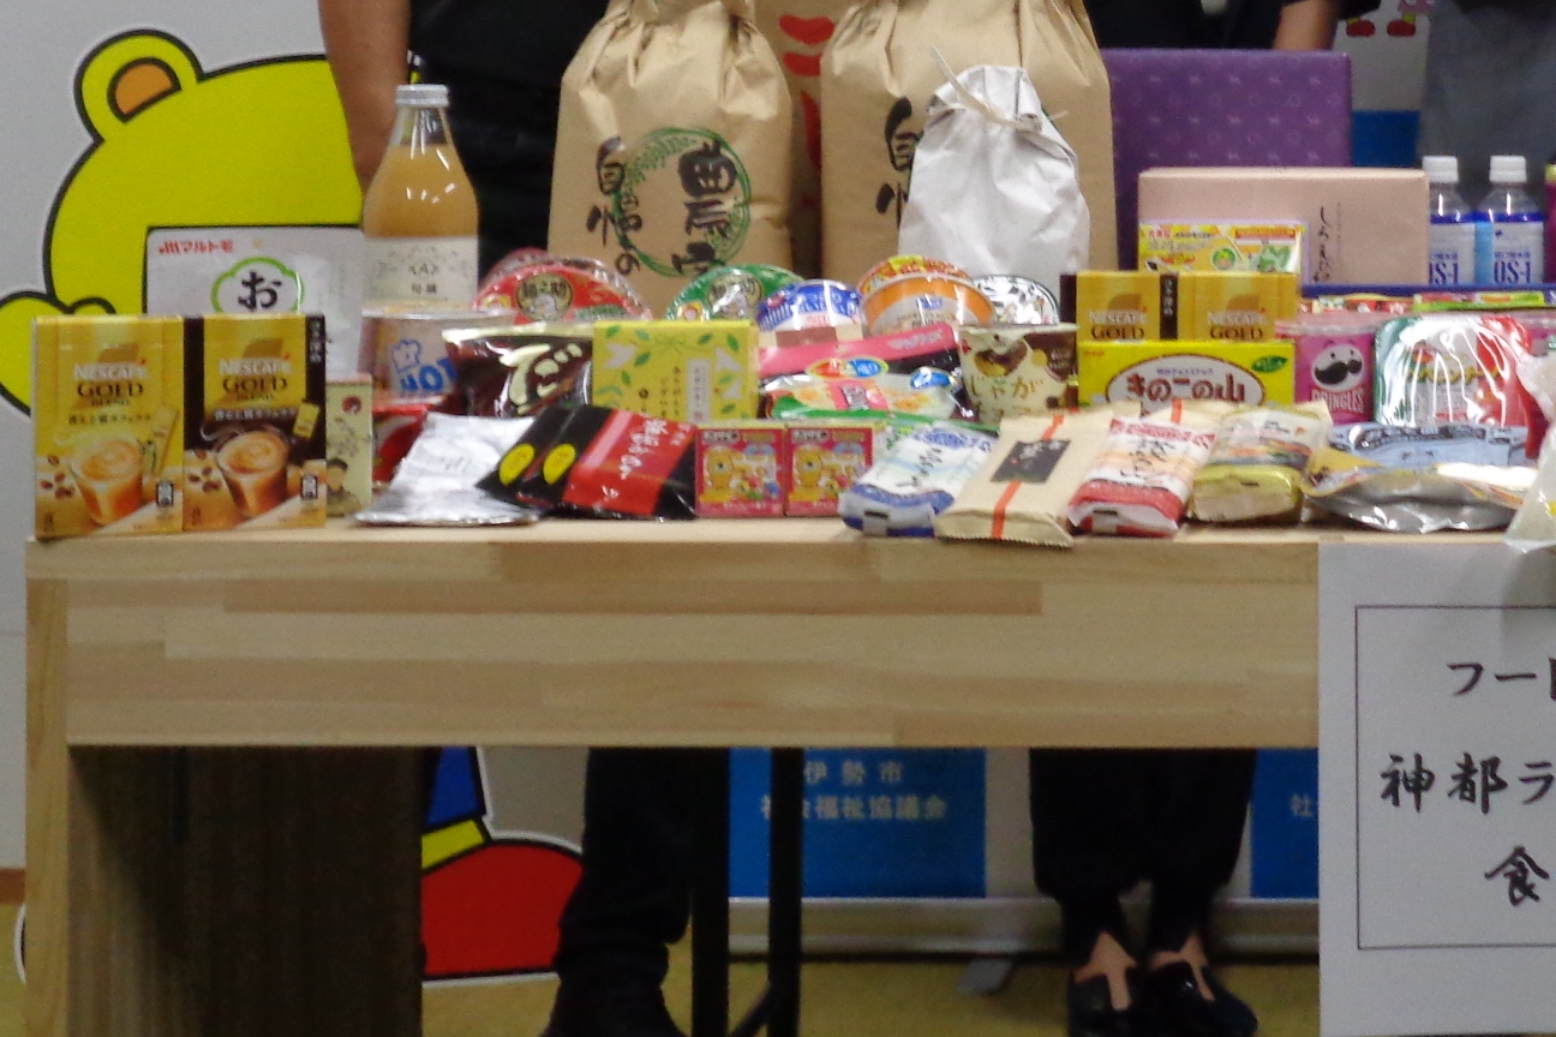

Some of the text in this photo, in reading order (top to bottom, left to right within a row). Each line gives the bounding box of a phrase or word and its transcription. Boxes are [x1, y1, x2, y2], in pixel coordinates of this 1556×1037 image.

[182, 240, 233, 253] マルトモ
[1494, 261, 1531, 284] OS-1
[238, 271, 283, 311] お
[1091, 325, 1145, 341] GOLD
[1209, 325, 1263, 341] GOLD
[76, 381, 144, 399] GOLD
[222, 376, 288, 394] GOLD
[761, 794, 946, 821] 福祉協議会
